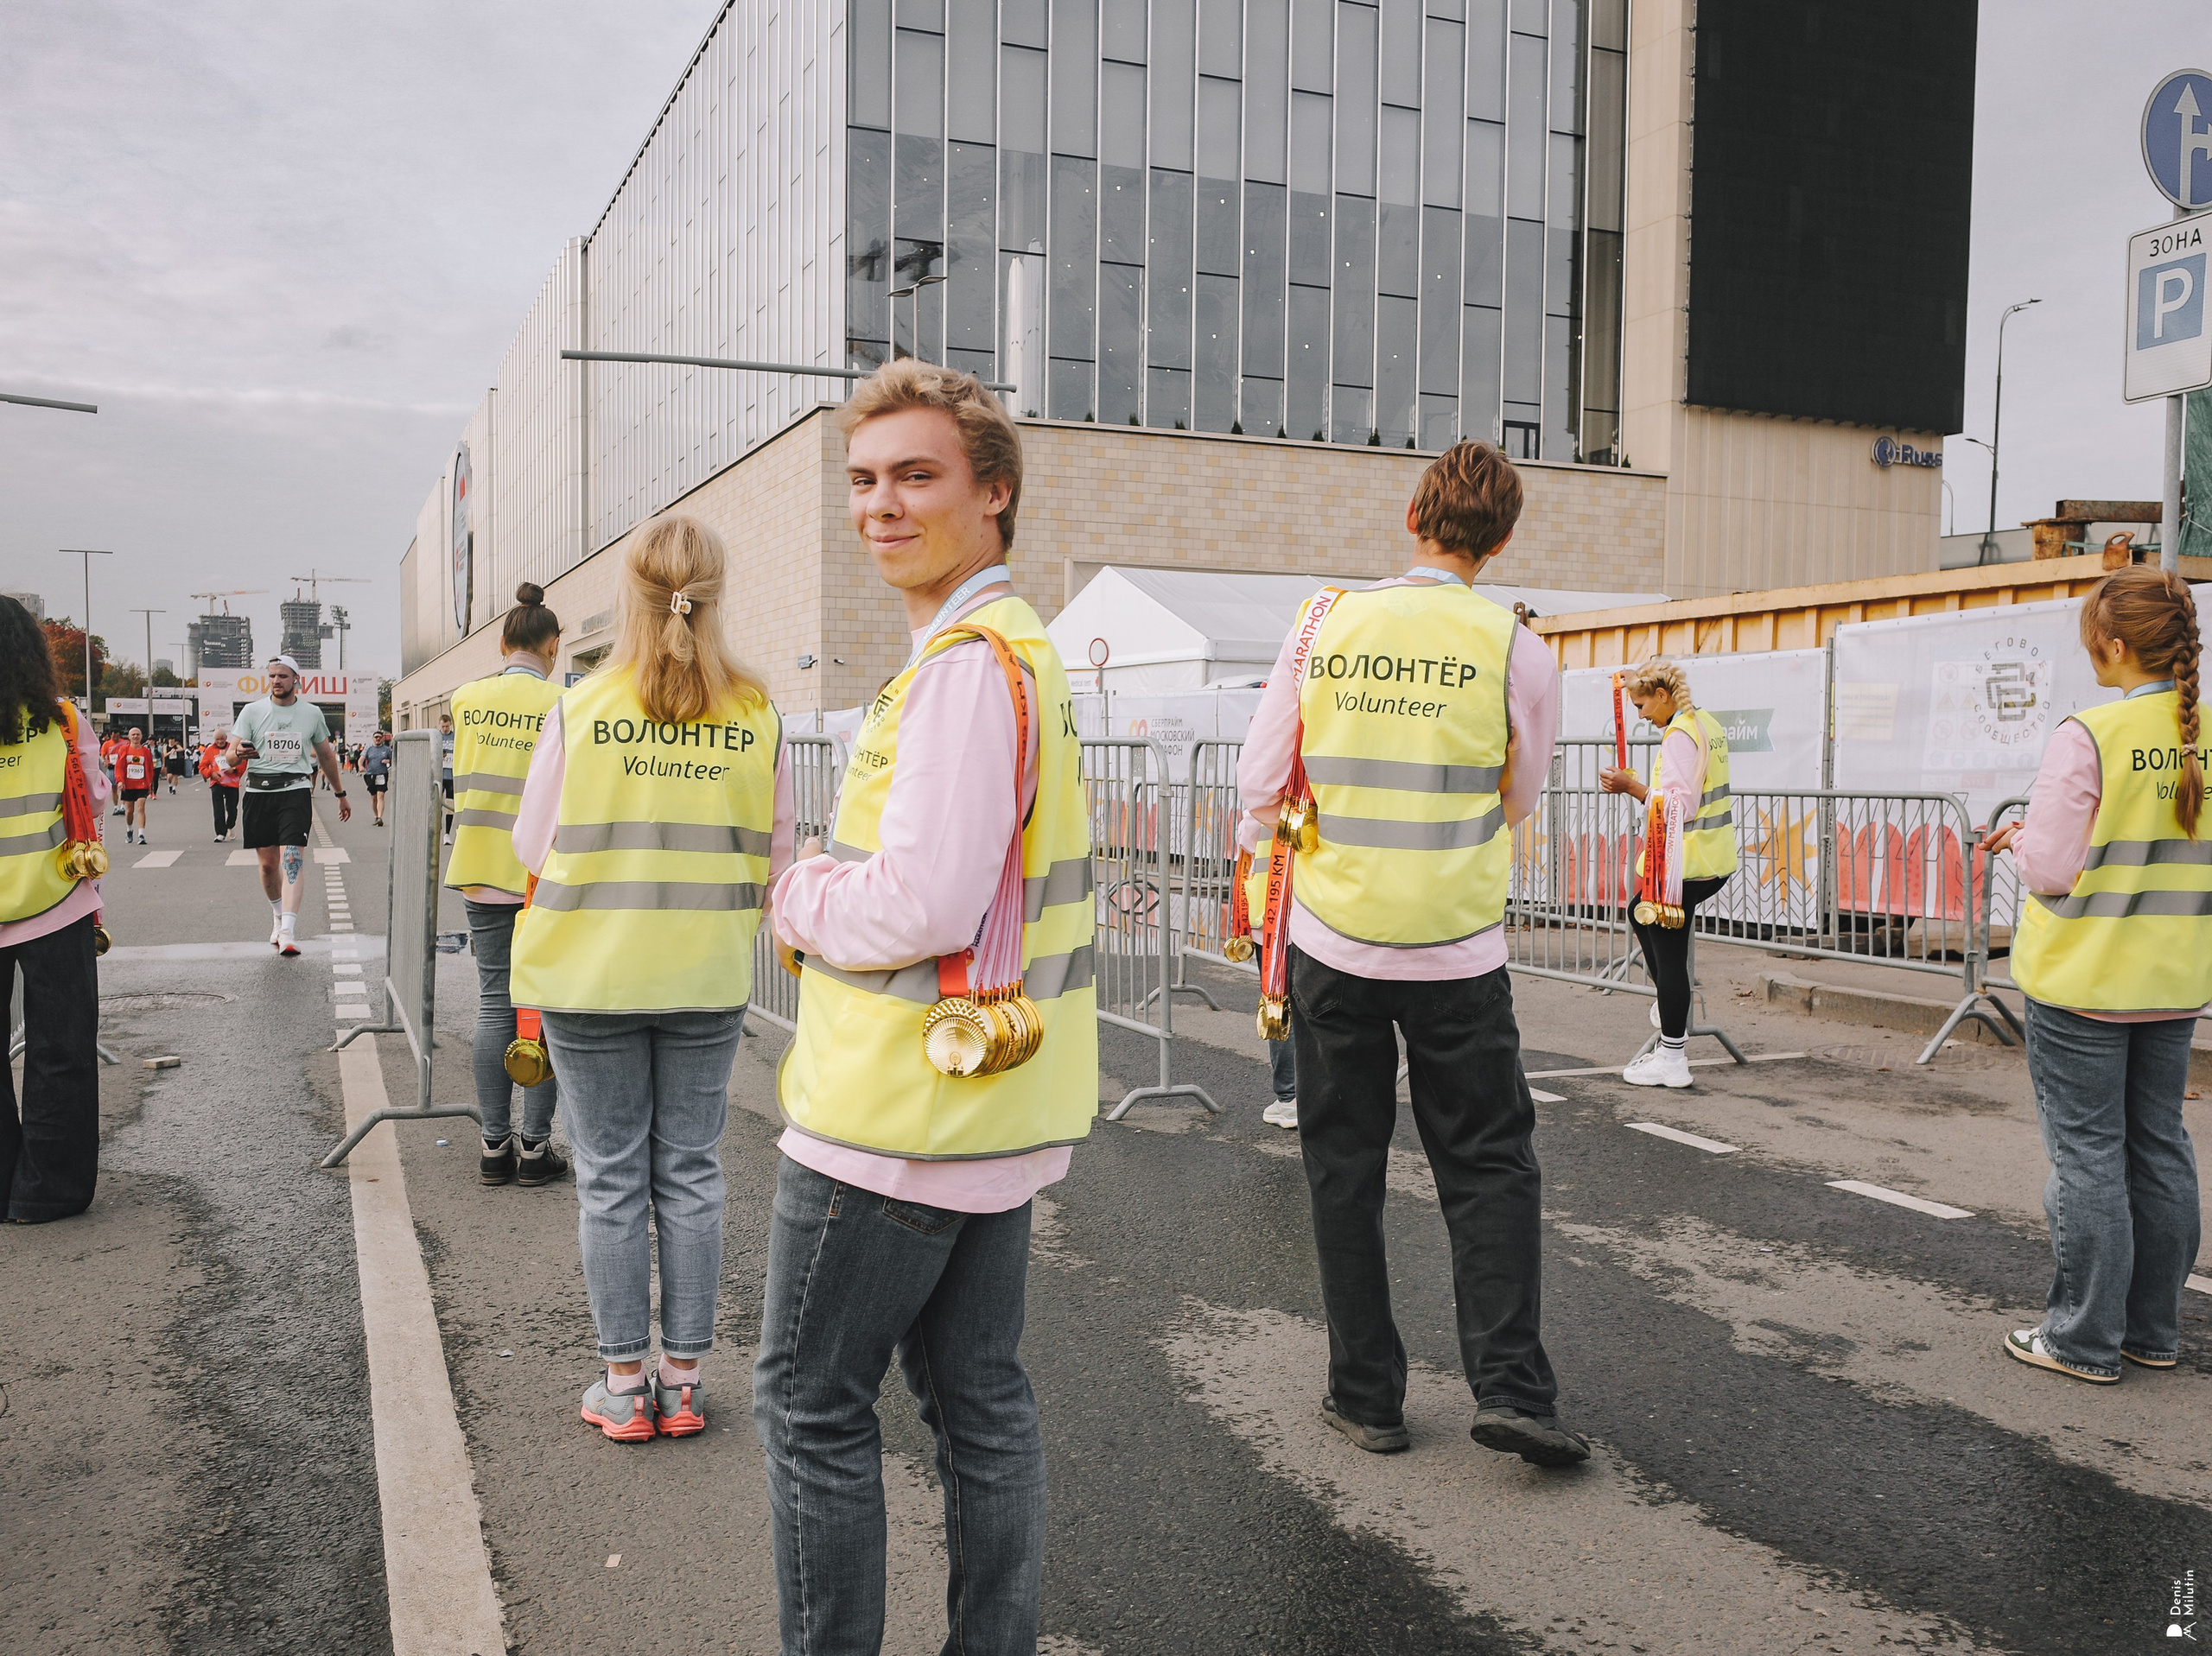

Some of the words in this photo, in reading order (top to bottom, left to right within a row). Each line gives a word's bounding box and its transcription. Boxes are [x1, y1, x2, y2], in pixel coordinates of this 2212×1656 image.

[2150, 228, 2202, 257] ЗОНА
[2153, 267, 2195, 339] P
[923, 587, 971, 640] VOLUNTEER
[1309, 654, 1478, 688] ВОЛОНТЁР
[1975, 637, 2048, 675] БЕГОВОЕ
[238, 675, 347, 695] ФИИШ
[1335, 691, 1447, 718] Volunteer
[594, 719, 754, 753] ВОЛОНТЁР
[1974, 701, 2050, 746] СООБЩЕСТВО
[267, 739, 301, 750] 18706
[623, 755, 731, 782] Volunteer
[1271, 854, 1286, 876] KM
[1267, 880, 1282, 925] 42.195
